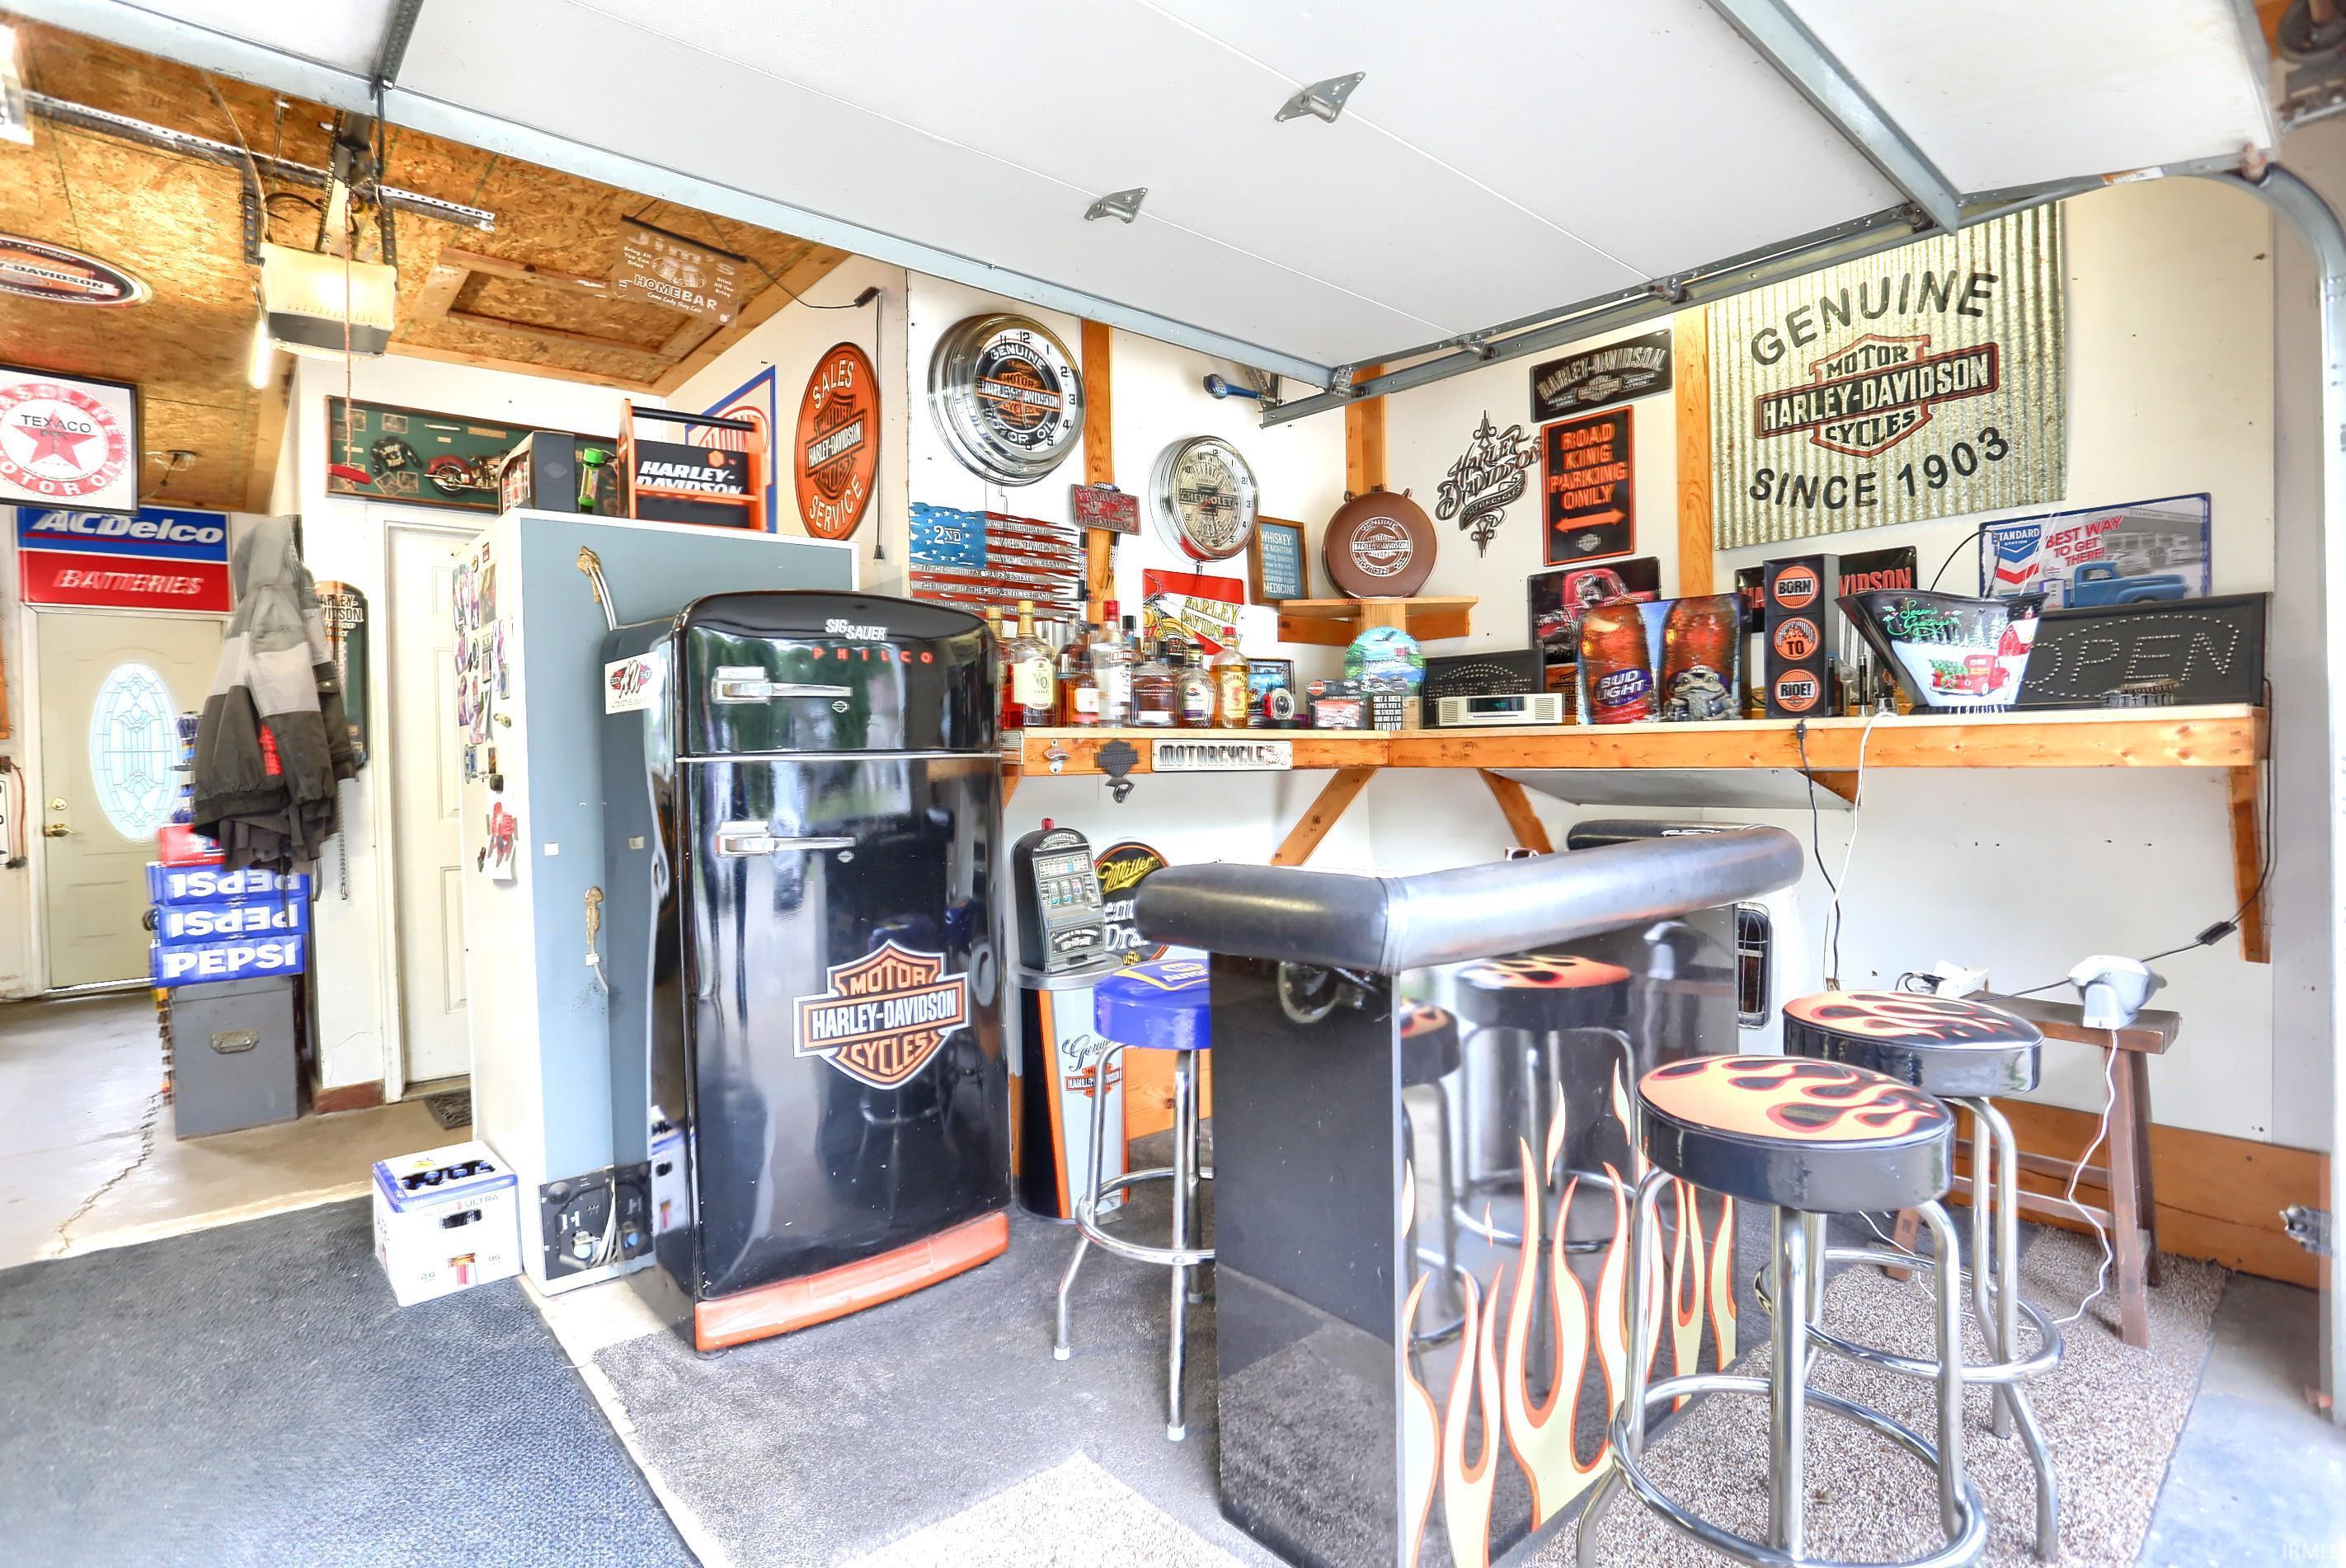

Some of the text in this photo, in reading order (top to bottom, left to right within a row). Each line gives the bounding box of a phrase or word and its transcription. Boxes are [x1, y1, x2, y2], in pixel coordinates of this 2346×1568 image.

[1751, 270, 1999, 365] GENUINE
[990, 344, 1047, 370] GENUINE
[1826, 344, 1909, 378] MOTOR
[812, 359, 854, 409] SALES
[1536, 346, 1667, 401] HARLEY-DAVIDSON
[1763, 352, 1991, 431] HARLEY-DAVIDSON
[21, 415, 92, 434] TEXACO
[1037, 421, 1055, 439] OIL
[1561, 423, 1615, 450] ROAD
[1825, 410, 1916, 448] CYCLES
[808, 420, 862, 468] HARLEY-DAVIDSON
[1564, 444, 1614, 470] KING
[639, 461, 736, 482] HARLEY-
[1549, 462, 1629, 494] PARKING
[1749, 426, 2009, 509] SINCE 1903
[636, 476, 744, 495] DAVIDSON
[1562, 484, 1615, 510] ONLY
[809, 473, 863, 533] SERVICE
[1182, 491, 1233, 507] CHEVROLET
[31, 509, 224, 544] ACDelco
[933, 524, 962, 545] 2ND
[2045, 514, 2124, 548] BEST WAY
[2054, 541, 2099, 558] TO GET
[2065, 547, 2106, 567] THERE!
[53, 569, 205, 597] BATTERIES
[1263, 582, 1295, 595] MEDICINE
[1777, 580, 1812, 594] BORN
[319, 593, 359, 608] ARLEY-
[1185, 596, 1242, 626] HARLEY
[321, 606, 364, 622] VIDSON
[1180, 607, 1223, 641] DAVIDS
[825, 618, 888, 641] SIG SAUER
[811, 646, 935, 664] PHILCO
[1786, 640, 1805, 655] TO
[1596, 679, 1645, 701] LIGHT
[1601, 669, 1640, 689] BUD
[1779, 683, 1812, 697] RIDE!
[1159, 744, 1265, 767] MOTORCYCLE
[167, 870, 300, 899] PEPSI
[1096, 857, 1159, 893] Miller
[170, 904, 299, 937] PEPSI
[163, 941, 296, 979] PEPSI
[849, 957, 926, 996] MOTOR
[811, 988, 957, 1040] HARLEY-DAVIDSON
[851, 1030, 929, 1076] CYCLES
[464, 1195, 499, 1208] ULTRA
